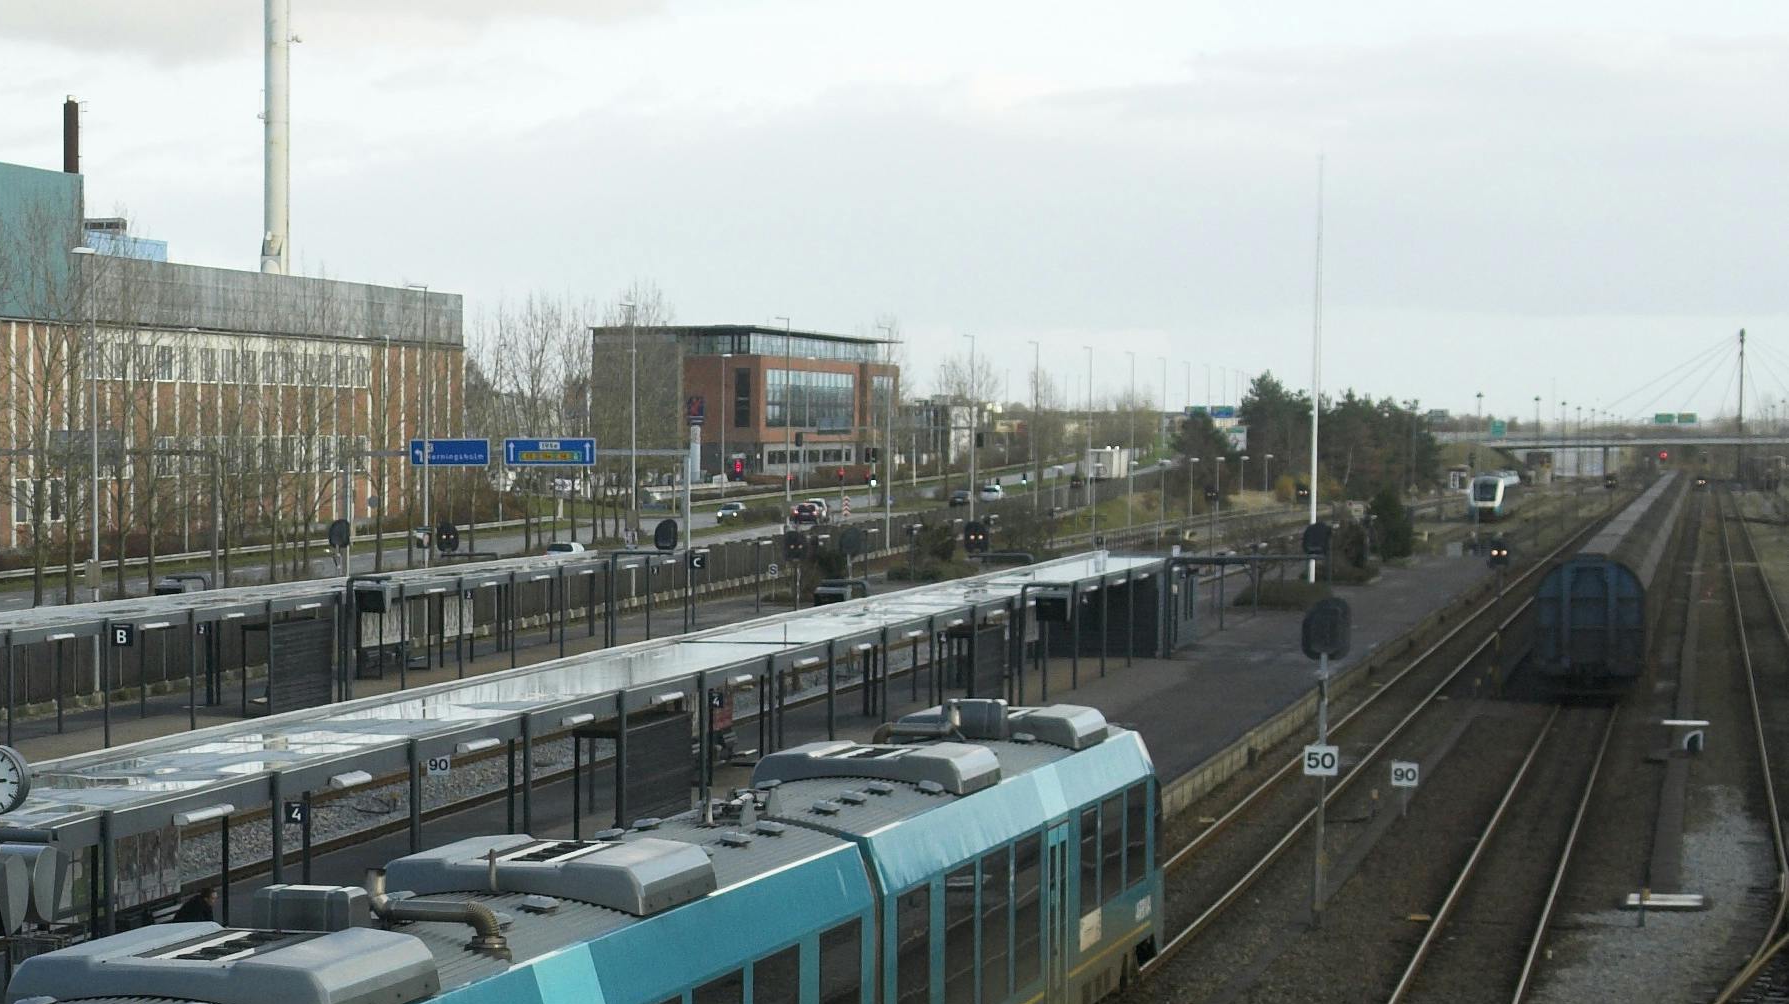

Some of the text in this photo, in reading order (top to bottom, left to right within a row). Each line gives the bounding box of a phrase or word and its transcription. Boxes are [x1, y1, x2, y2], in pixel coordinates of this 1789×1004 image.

[693, 557, 702, 568] C
[769, 565, 777, 575] S
[116, 629, 127, 643] B
[428, 759, 448, 771] 90
[1307, 752, 1336, 769] 50
[1393, 767, 1417, 782] 90
[291, 806, 301, 821] 4
